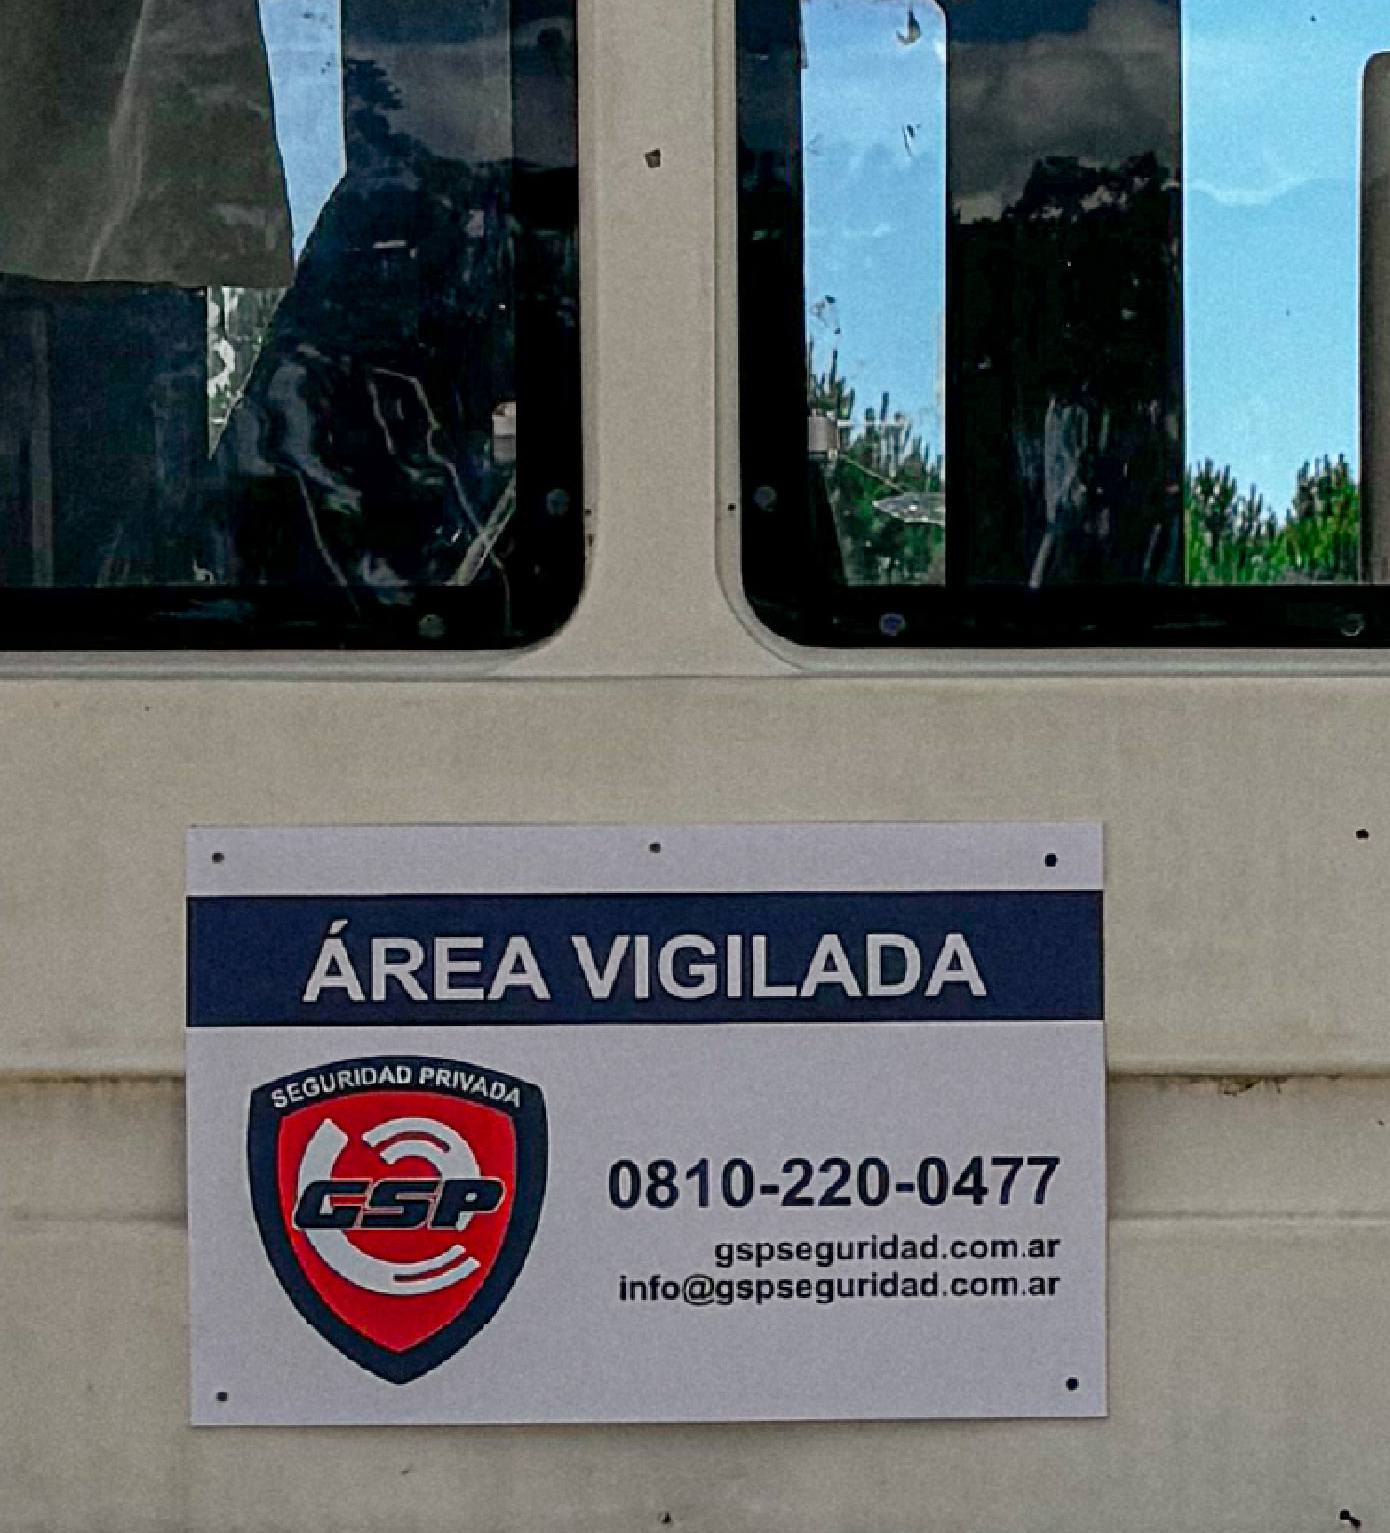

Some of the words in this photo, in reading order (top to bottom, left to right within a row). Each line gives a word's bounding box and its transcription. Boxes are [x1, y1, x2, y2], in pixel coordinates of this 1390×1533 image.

[302, 919, 551, 1003] ÁREA
[572, 932, 987, 1000] VIGILADA
[271, 1066, 412, 1109] SEGURIDAD
[418, 1066, 521, 1108] PRIVADA
[292, 1177, 506, 1231] GSP
[608, 1155, 1061, 1209] 0810-220-0477
[714, 1233, 1061, 1268] gspseguridad.com.ar
[619, 1272, 1061, 1306] info@gspseguridad.com.ar
